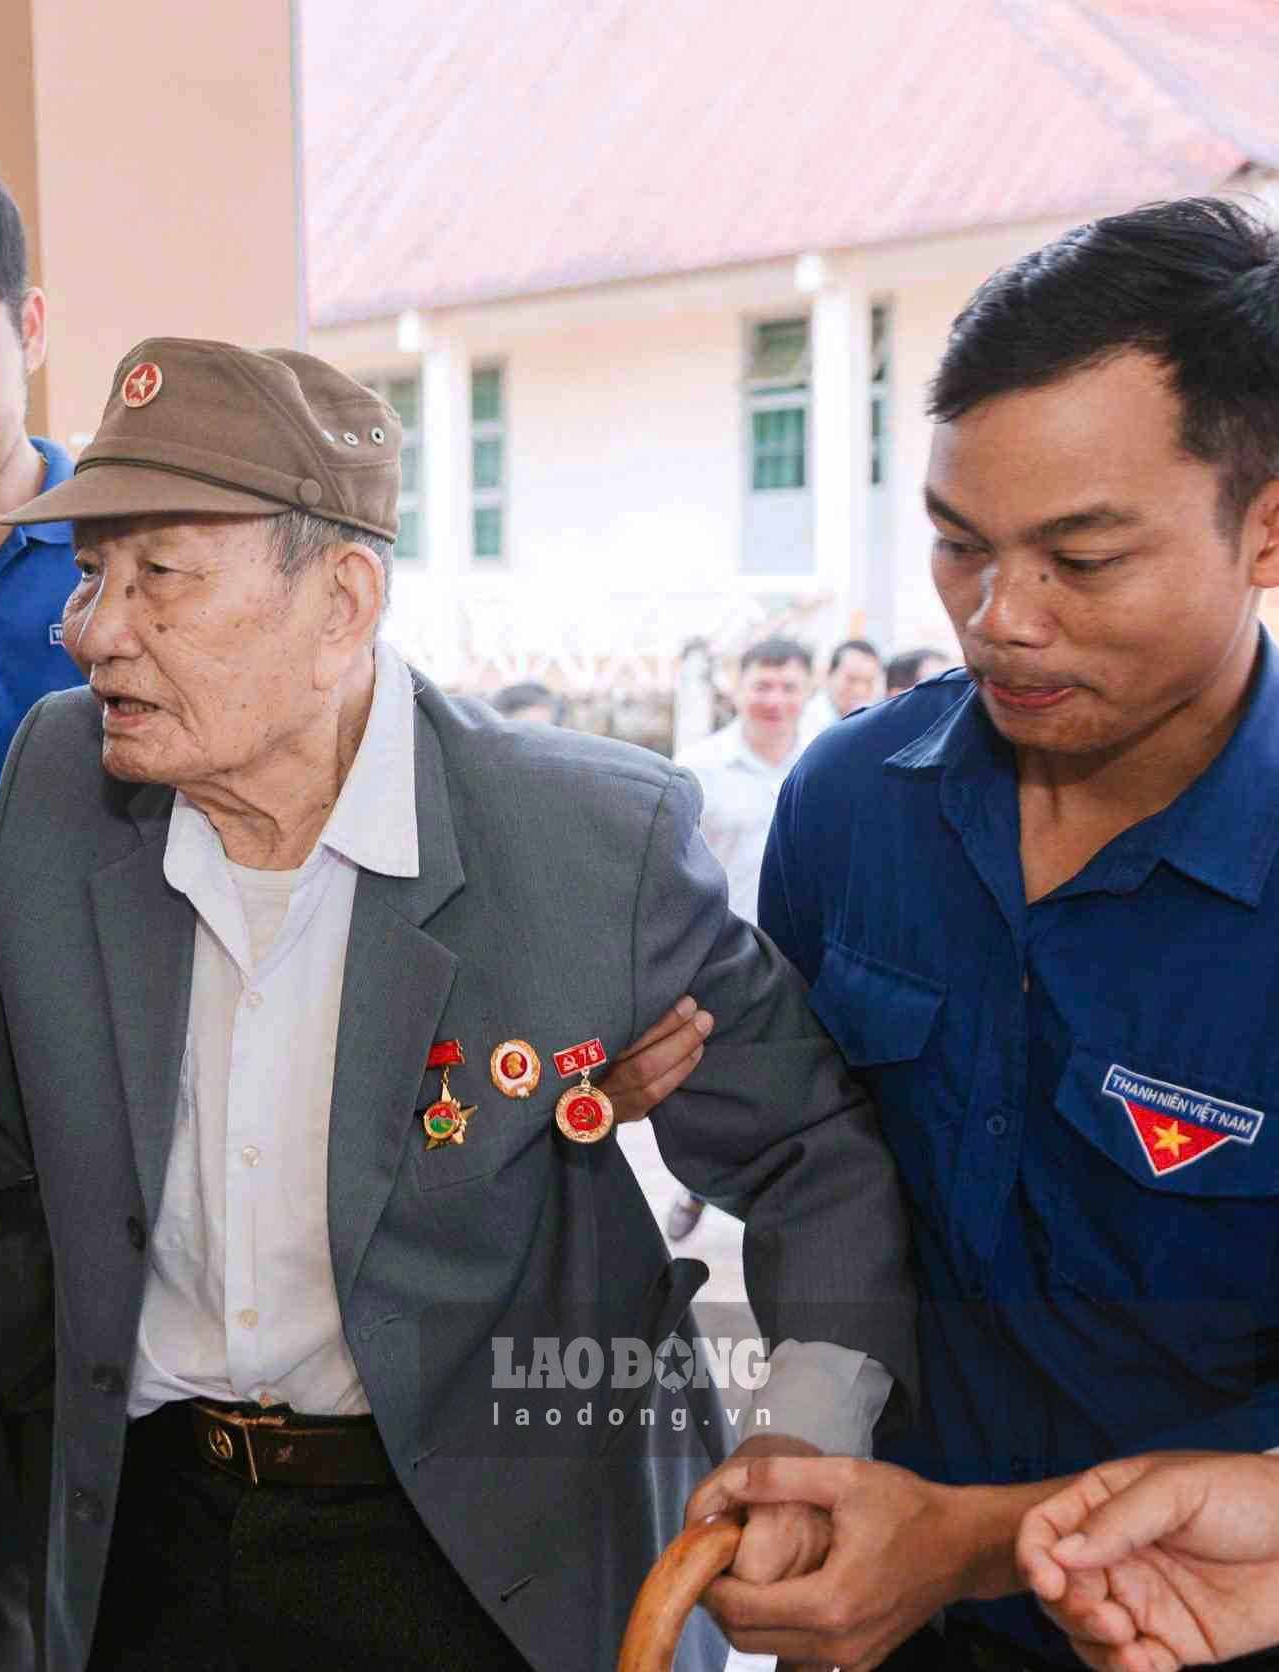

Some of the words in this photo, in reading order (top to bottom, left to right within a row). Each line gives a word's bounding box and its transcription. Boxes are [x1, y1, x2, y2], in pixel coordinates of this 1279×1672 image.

[1111, 1073, 1157, 1103] THANH
[1156, 1091, 1190, 1113] NIÊN
[1190, 1102, 1219, 1124] VIỆT
[1218, 1111, 1254, 1133] NAM
